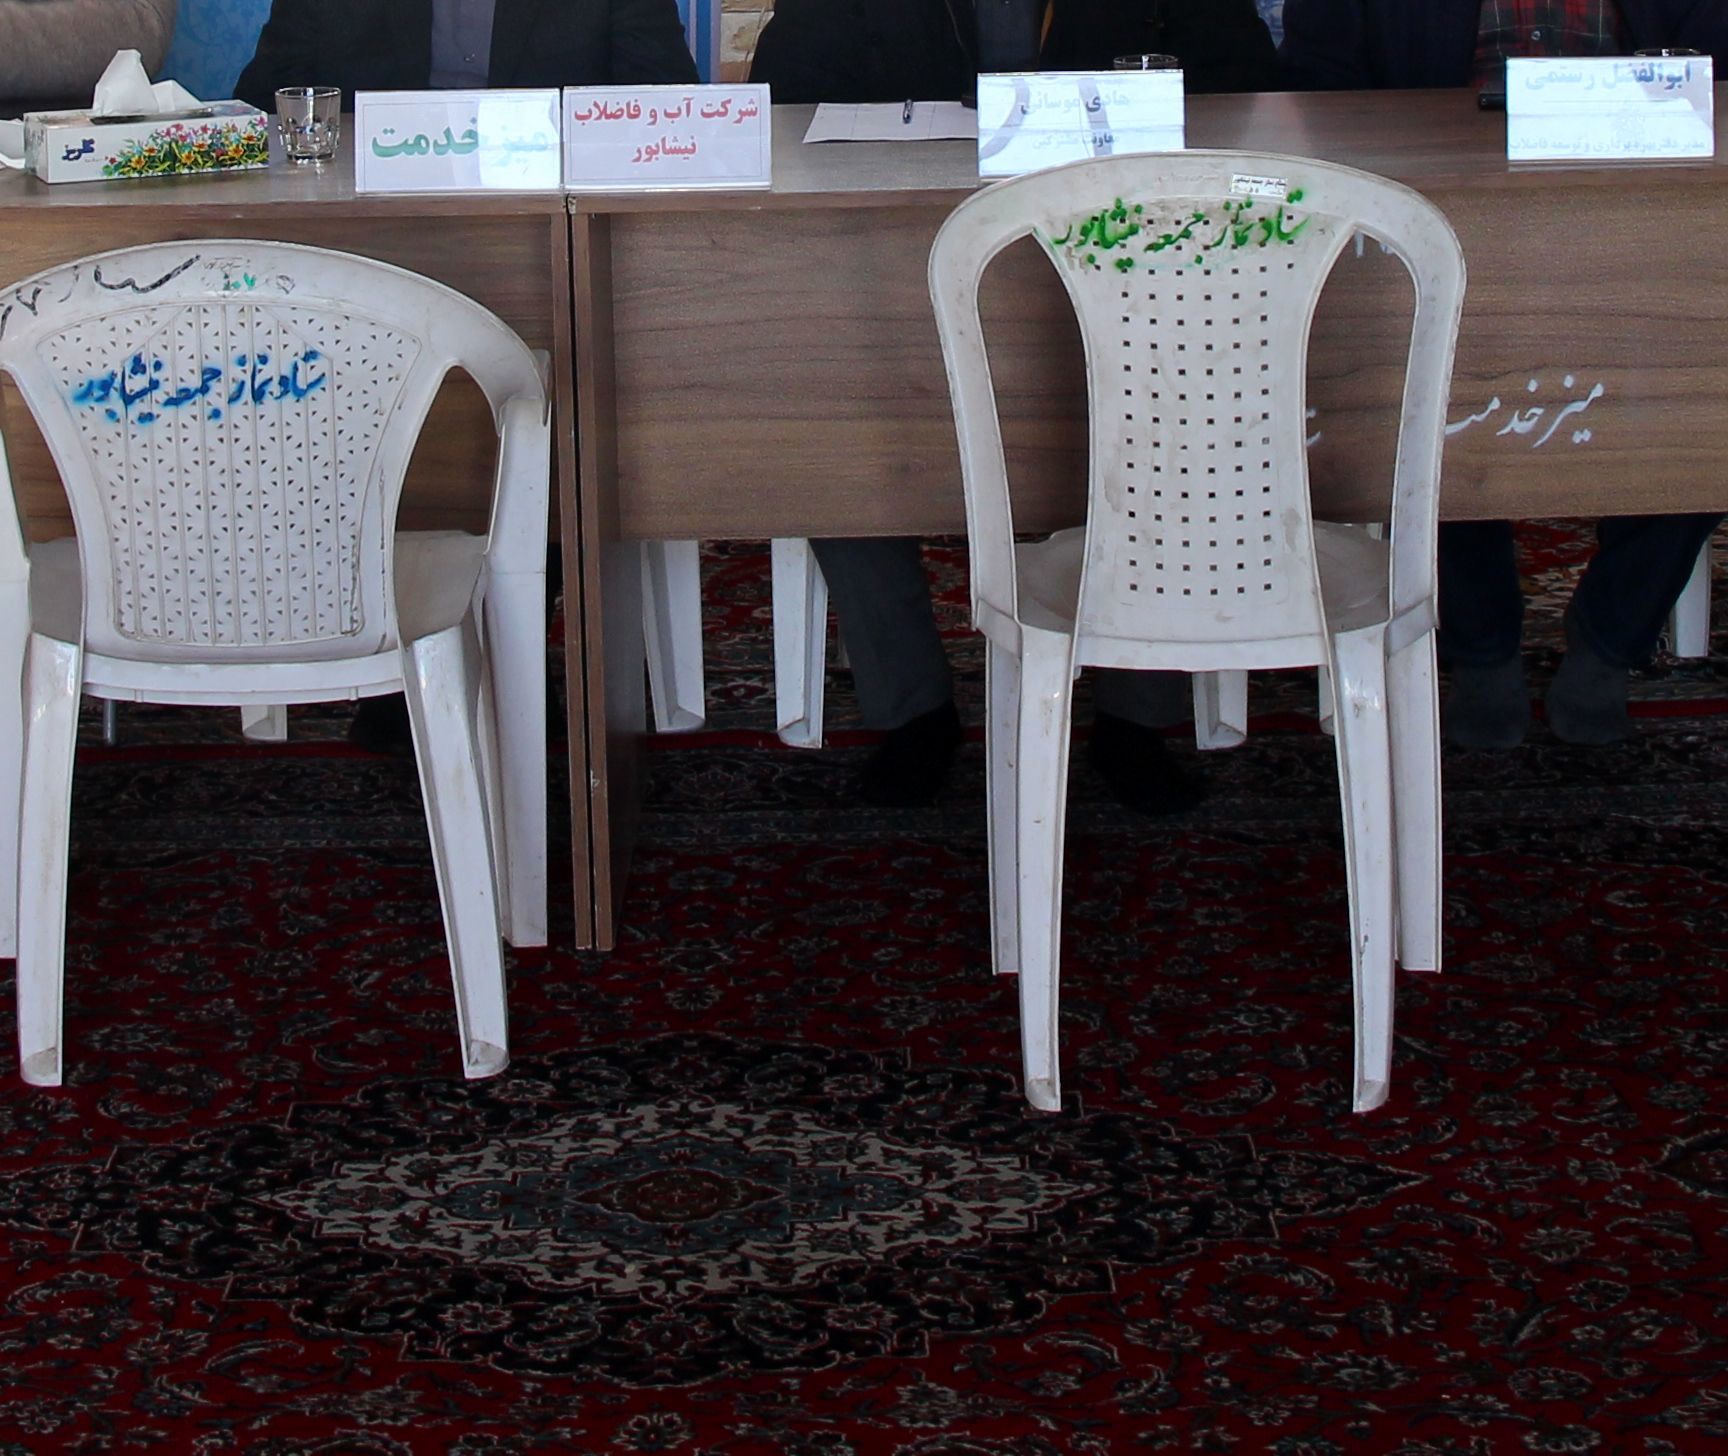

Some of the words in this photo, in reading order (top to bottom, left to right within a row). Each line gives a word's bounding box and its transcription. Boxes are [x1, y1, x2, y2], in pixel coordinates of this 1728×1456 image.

[1524, 64, 1597, 92] رستمی
[1601, 60, 1692, 91] ابوالفضل
[573, 99, 642, 124] فاضلاب
[648, 109, 659, 128] و
[663, 97, 693, 127] آب
[699, 97, 759, 126] شرکت
[1085, 89, 1130, 113] هادی
[370, 115, 480, 160] خدمت
[485, 123, 550, 168] میز
[631, 134, 697, 164] نیشابور
[1052, 197, 1143, 270] نیشابور
[1143, 211, 1205, 265] جمعه
[1210, 196, 1256, 249] نماز
[72, 352, 163, 425] نیشابور
[161, 365, 223, 421] جمعه
[228, 353, 272, 405] نماز
[1532, 374, 1605, 448] میز
